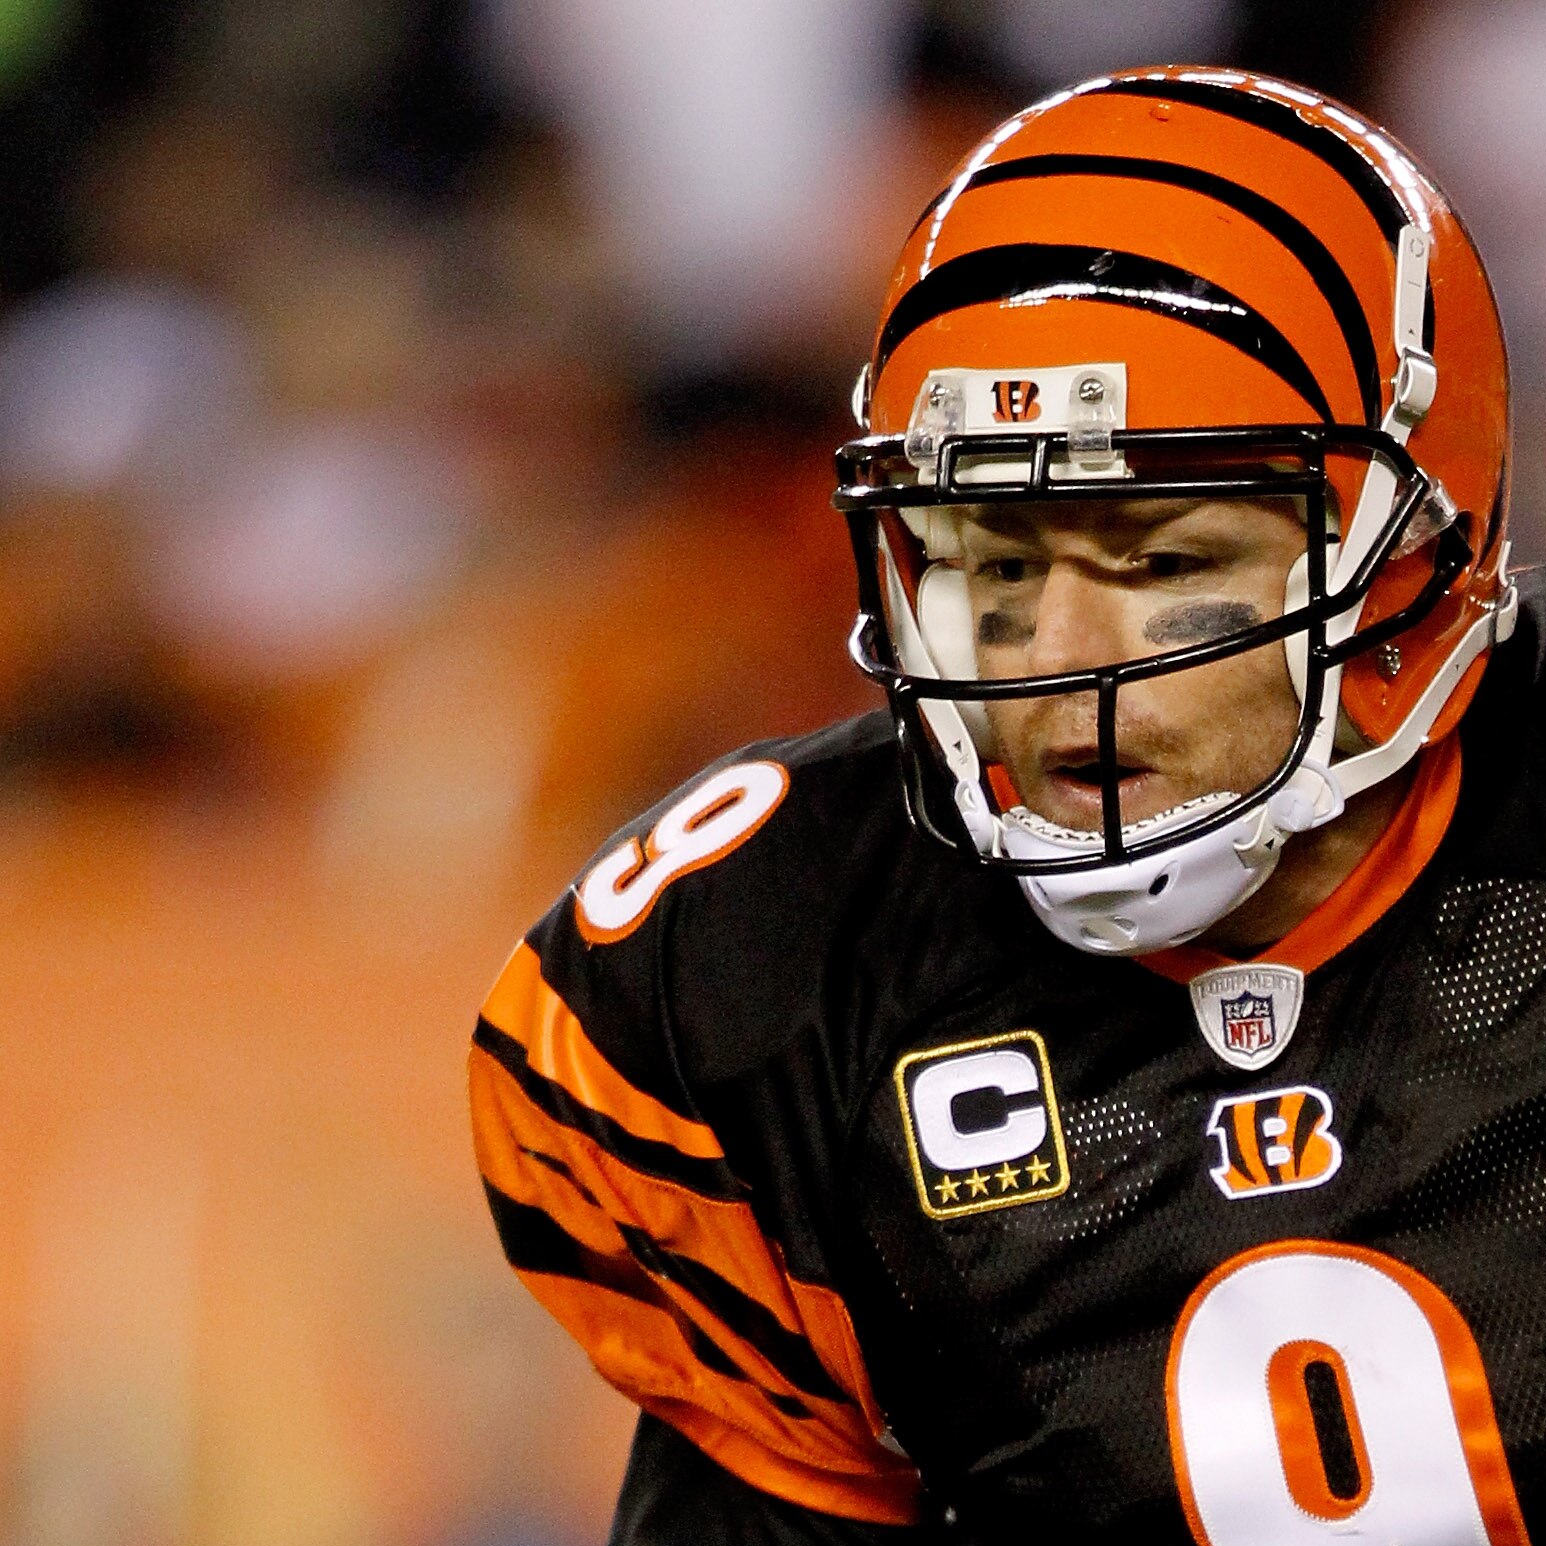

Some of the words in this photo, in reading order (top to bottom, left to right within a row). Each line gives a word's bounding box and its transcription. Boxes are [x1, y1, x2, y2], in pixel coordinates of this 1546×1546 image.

[574, 759, 791, 945] 9
[1227, 1020, 1271, 1050] NFL
[912, 1050, 1046, 1171] C
